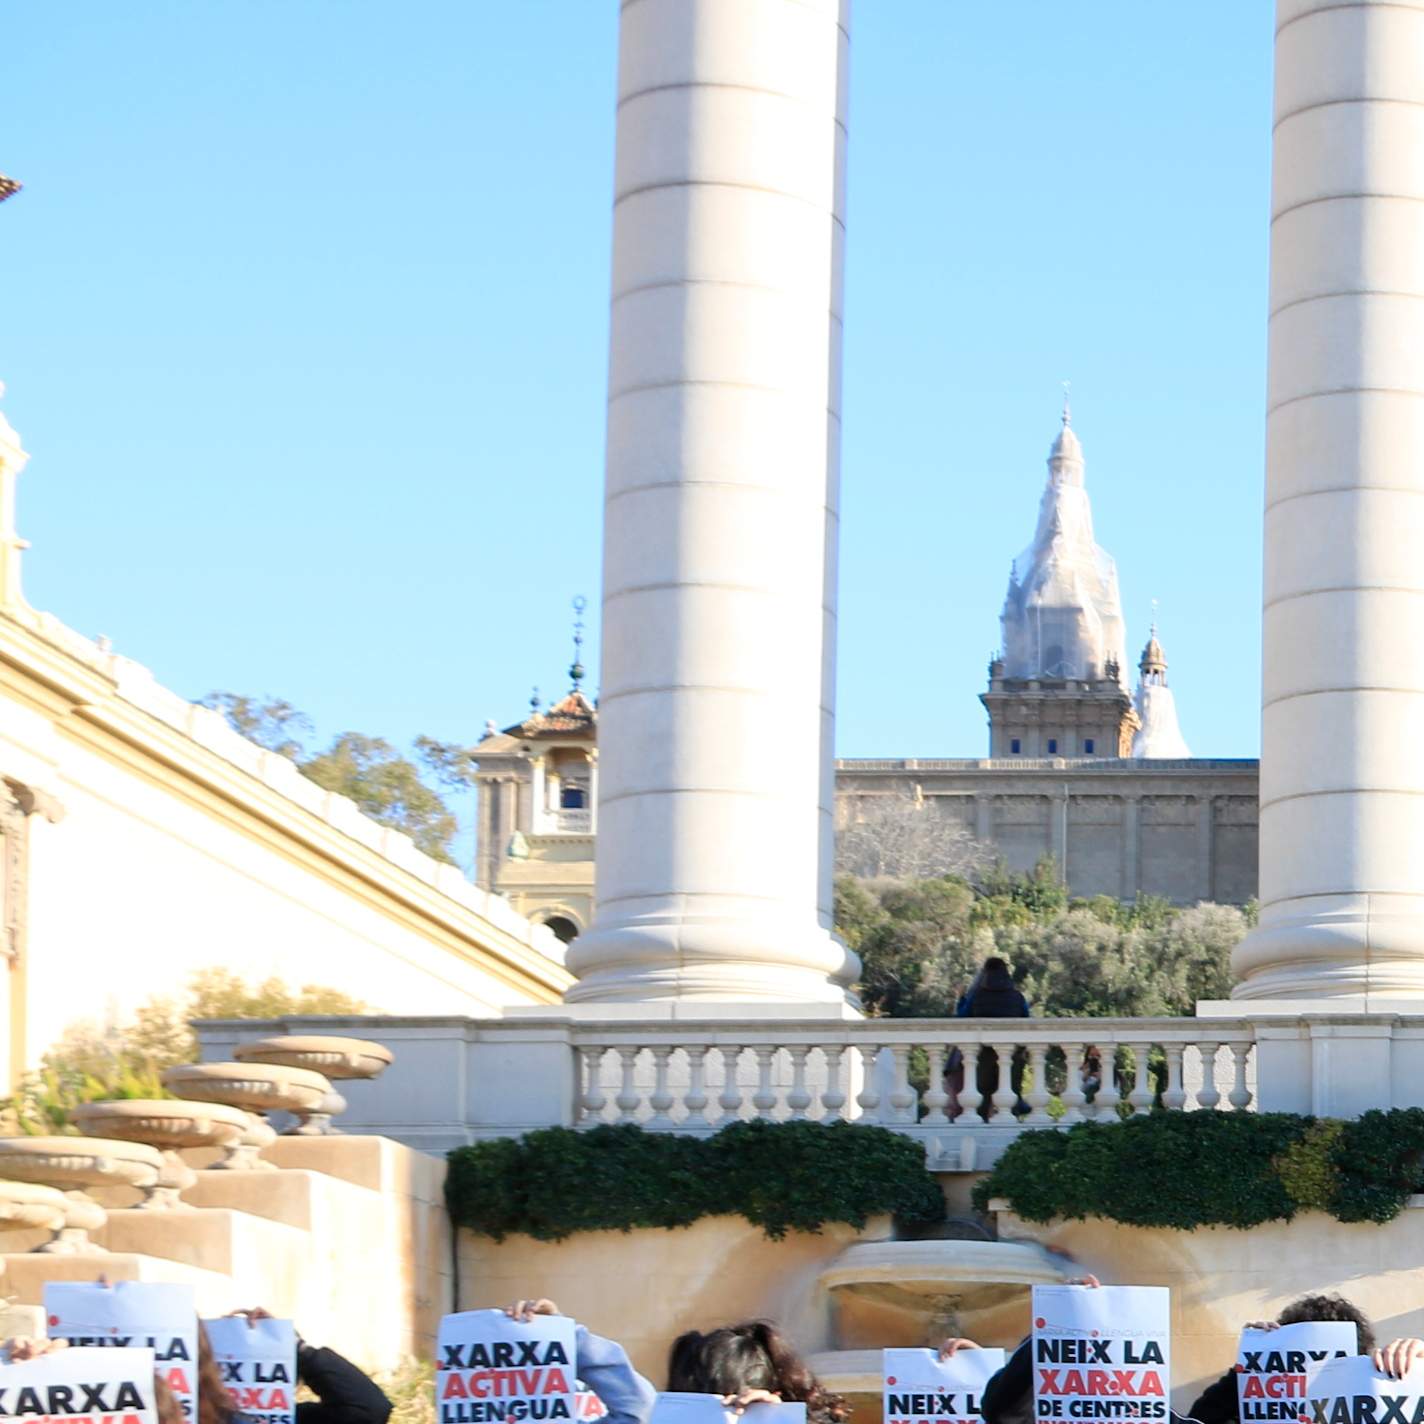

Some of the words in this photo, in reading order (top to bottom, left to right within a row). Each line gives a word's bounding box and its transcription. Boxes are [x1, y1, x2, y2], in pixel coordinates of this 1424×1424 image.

[443, 1341, 569, 1370] XARXA
[1037, 1339, 1113, 1364] NEIX
[1123, 1340, 1165, 1364] LA
[1243, 1350, 1346, 1373] XAR
[255, 1363, 290, 1383] LA
[443, 1368, 569, 1399] ACTIVA
[1039, 1369, 1165, 1396] XARXA
[1243, 1375, 1306, 1398] ACTI
[0, 1381, 146, 1417] ARXA
[888, 1394, 956, 1415] NEIX
[967, 1394, 982, 1415] L
[1038, 1400, 1062, 1416] DE
[1069, 1401, 1166, 1418] CENTRES
[1244, 1402, 1306, 1420] LLEN
[442, 1399, 570, 1424] LLENGUA
